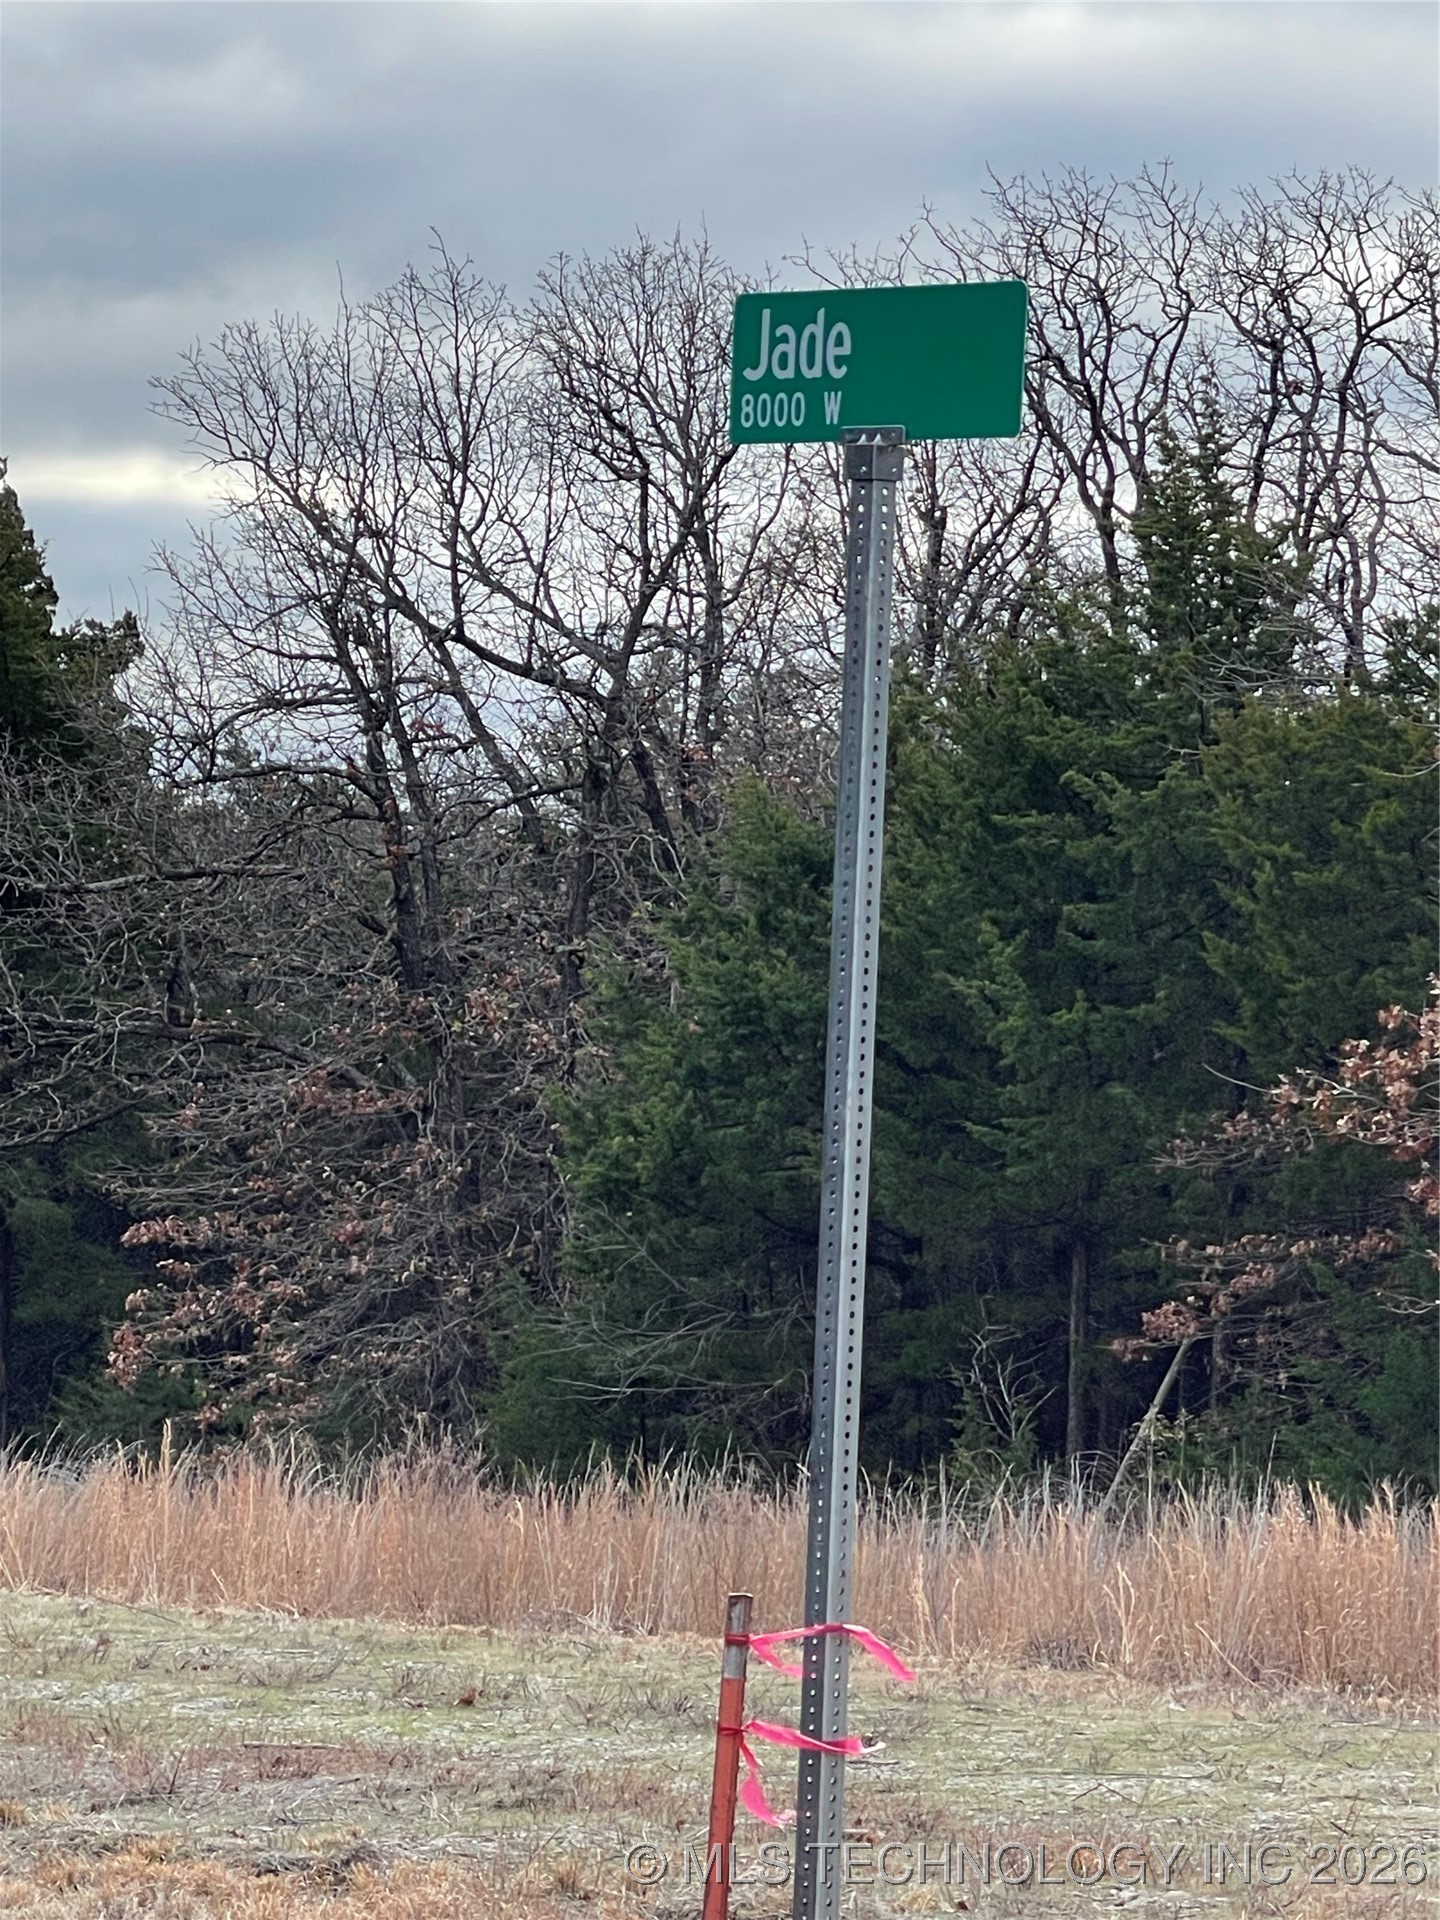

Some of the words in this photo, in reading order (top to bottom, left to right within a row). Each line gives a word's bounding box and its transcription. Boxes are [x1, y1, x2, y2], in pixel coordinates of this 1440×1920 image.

[743, 307, 851, 381] Jade
[740, 391, 806, 428] 8000
[824, 390, 842, 425] W
